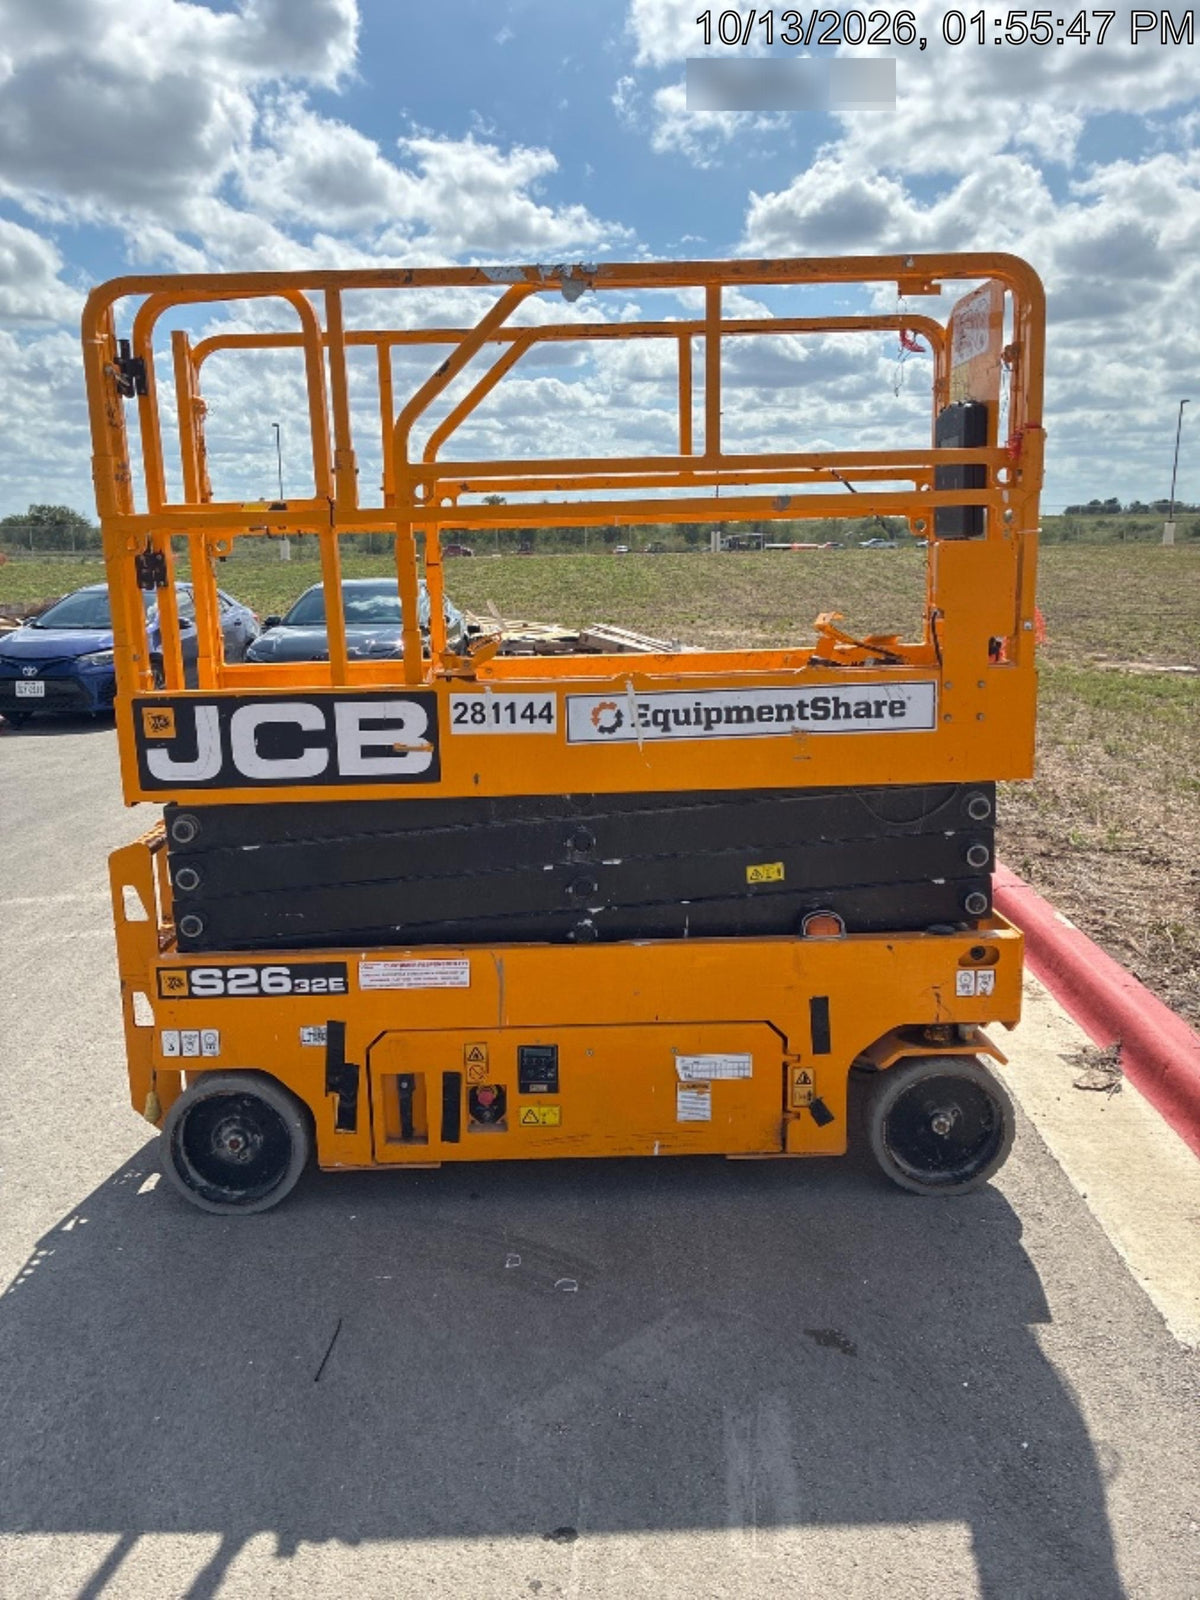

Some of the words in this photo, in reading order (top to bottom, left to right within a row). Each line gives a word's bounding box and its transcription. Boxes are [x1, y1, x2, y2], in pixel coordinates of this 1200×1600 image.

[453, 702, 554, 724] 281144
[630, 697, 906, 732] EquipmentShare
[146, 700, 433, 782] JCB
